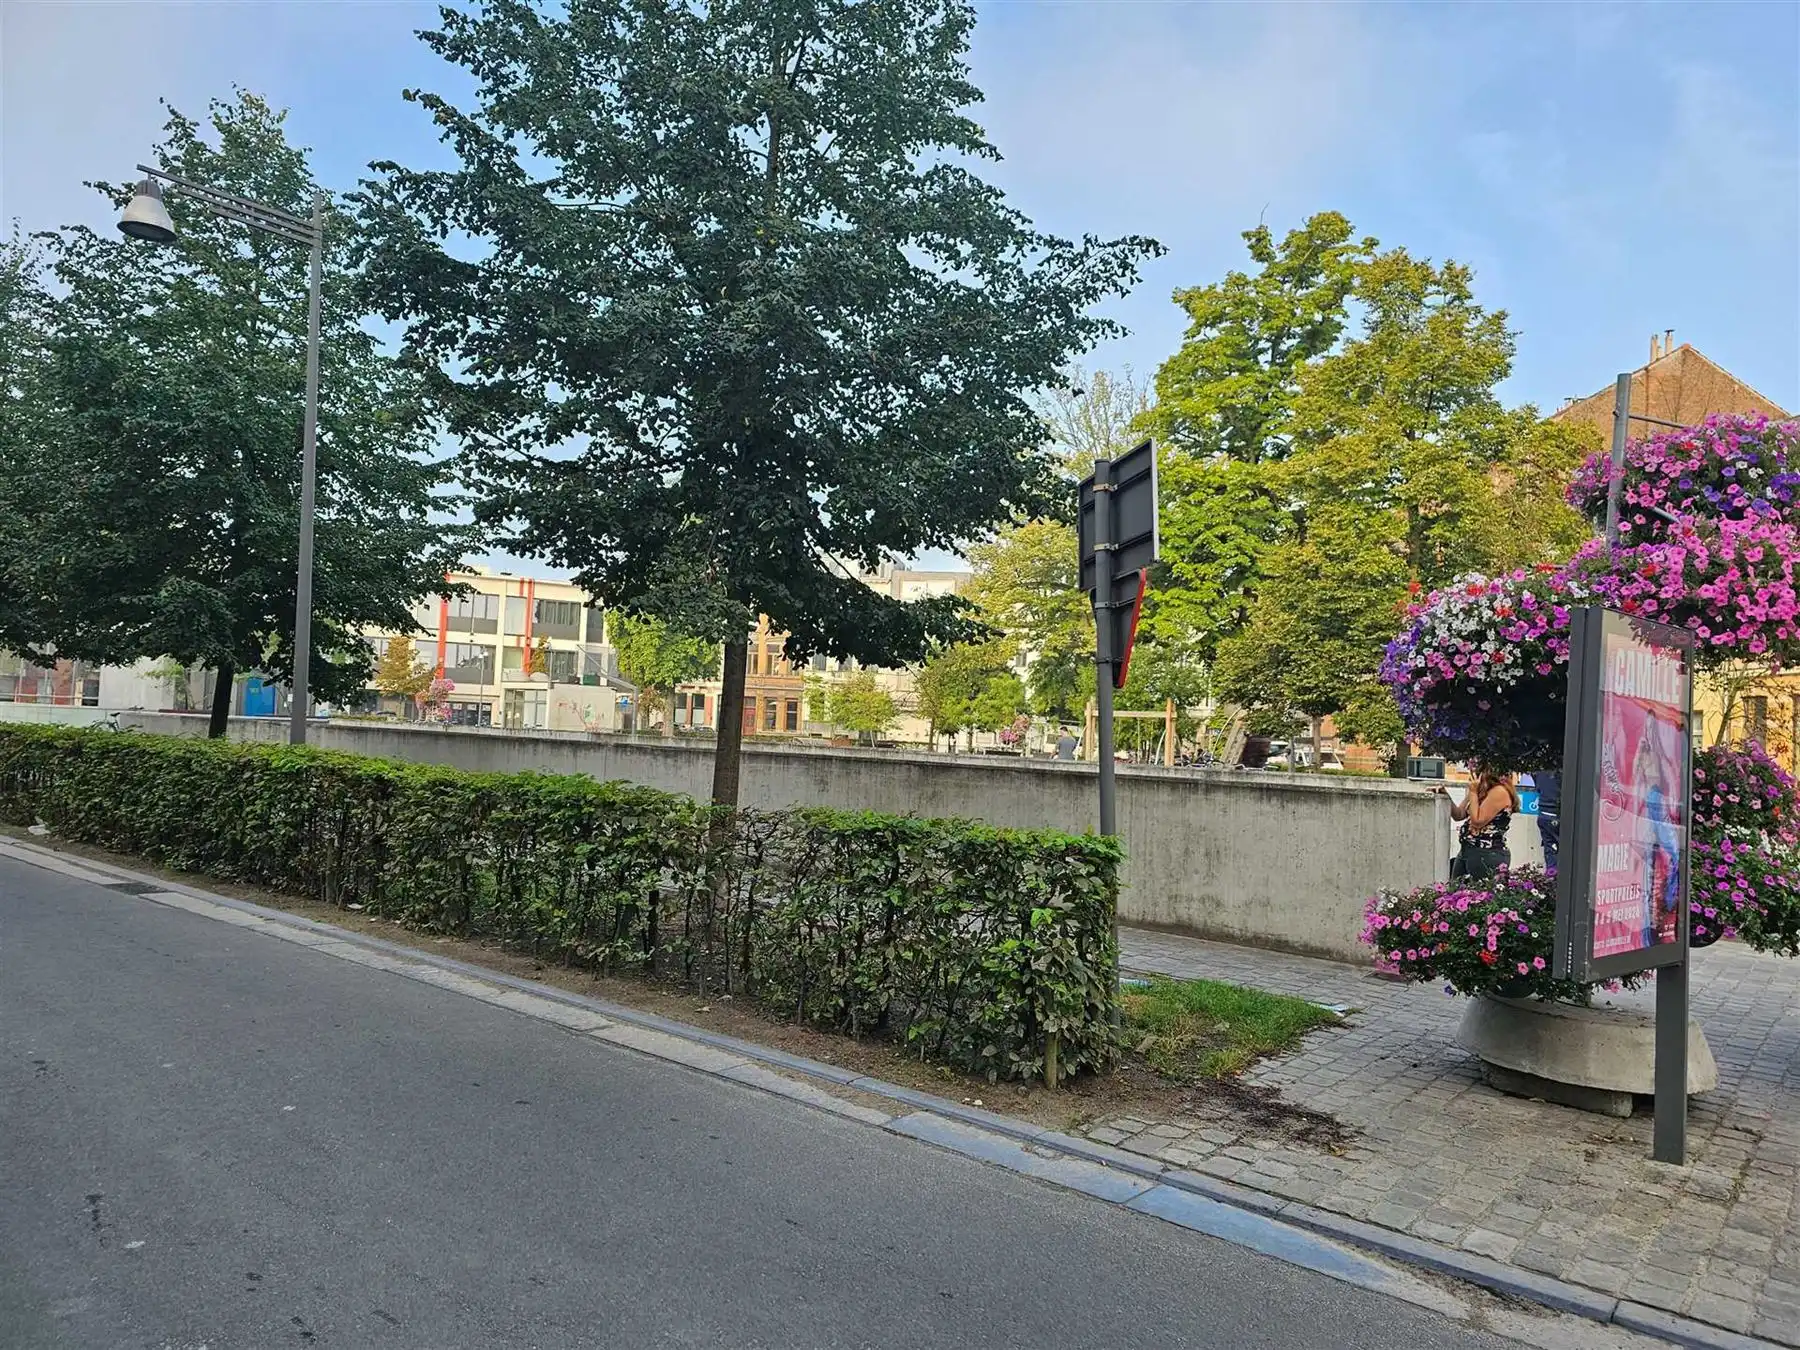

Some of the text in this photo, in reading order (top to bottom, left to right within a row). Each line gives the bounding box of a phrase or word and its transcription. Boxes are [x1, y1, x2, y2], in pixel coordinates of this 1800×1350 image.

[1615, 648, 1680, 705] CAMILLE
[1597, 842, 1630, 873] MAGIE
[1597, 884, 1641, 905] SPORTPALEIS
